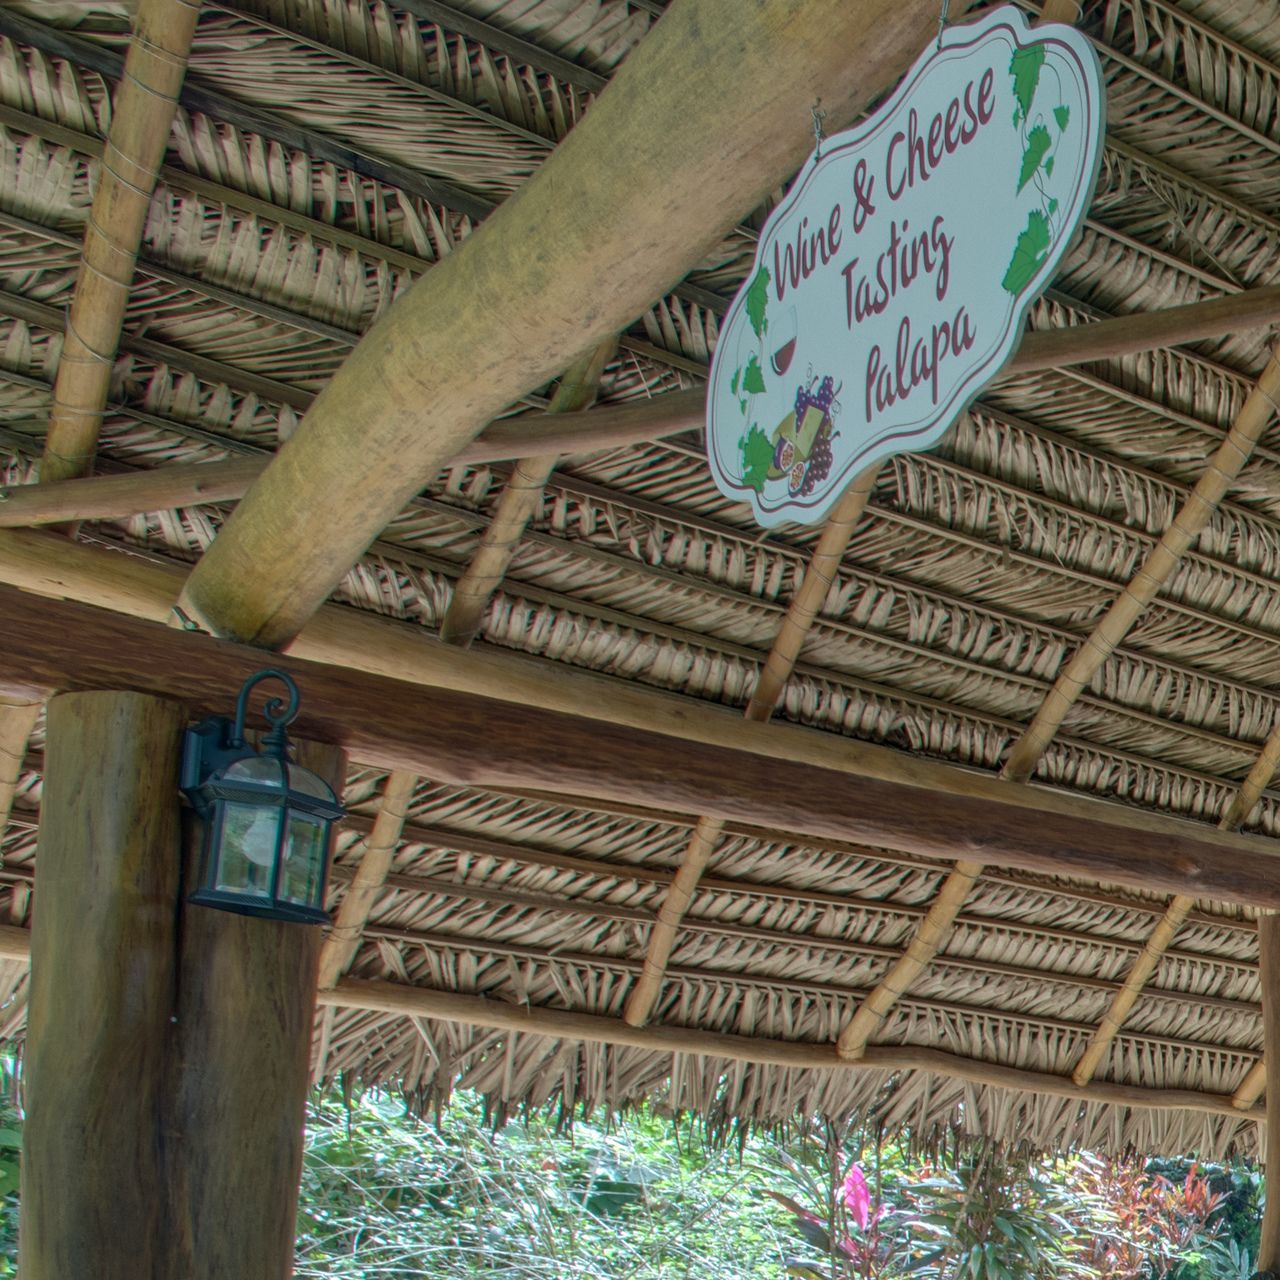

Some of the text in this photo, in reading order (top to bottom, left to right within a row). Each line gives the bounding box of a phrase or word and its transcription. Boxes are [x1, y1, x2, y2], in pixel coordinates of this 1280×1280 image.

[773, 66, 996, 301] Wine & Cheese
[840, 215, 955, 331] Tasting
[864, 305, 977, 423] Palapa
